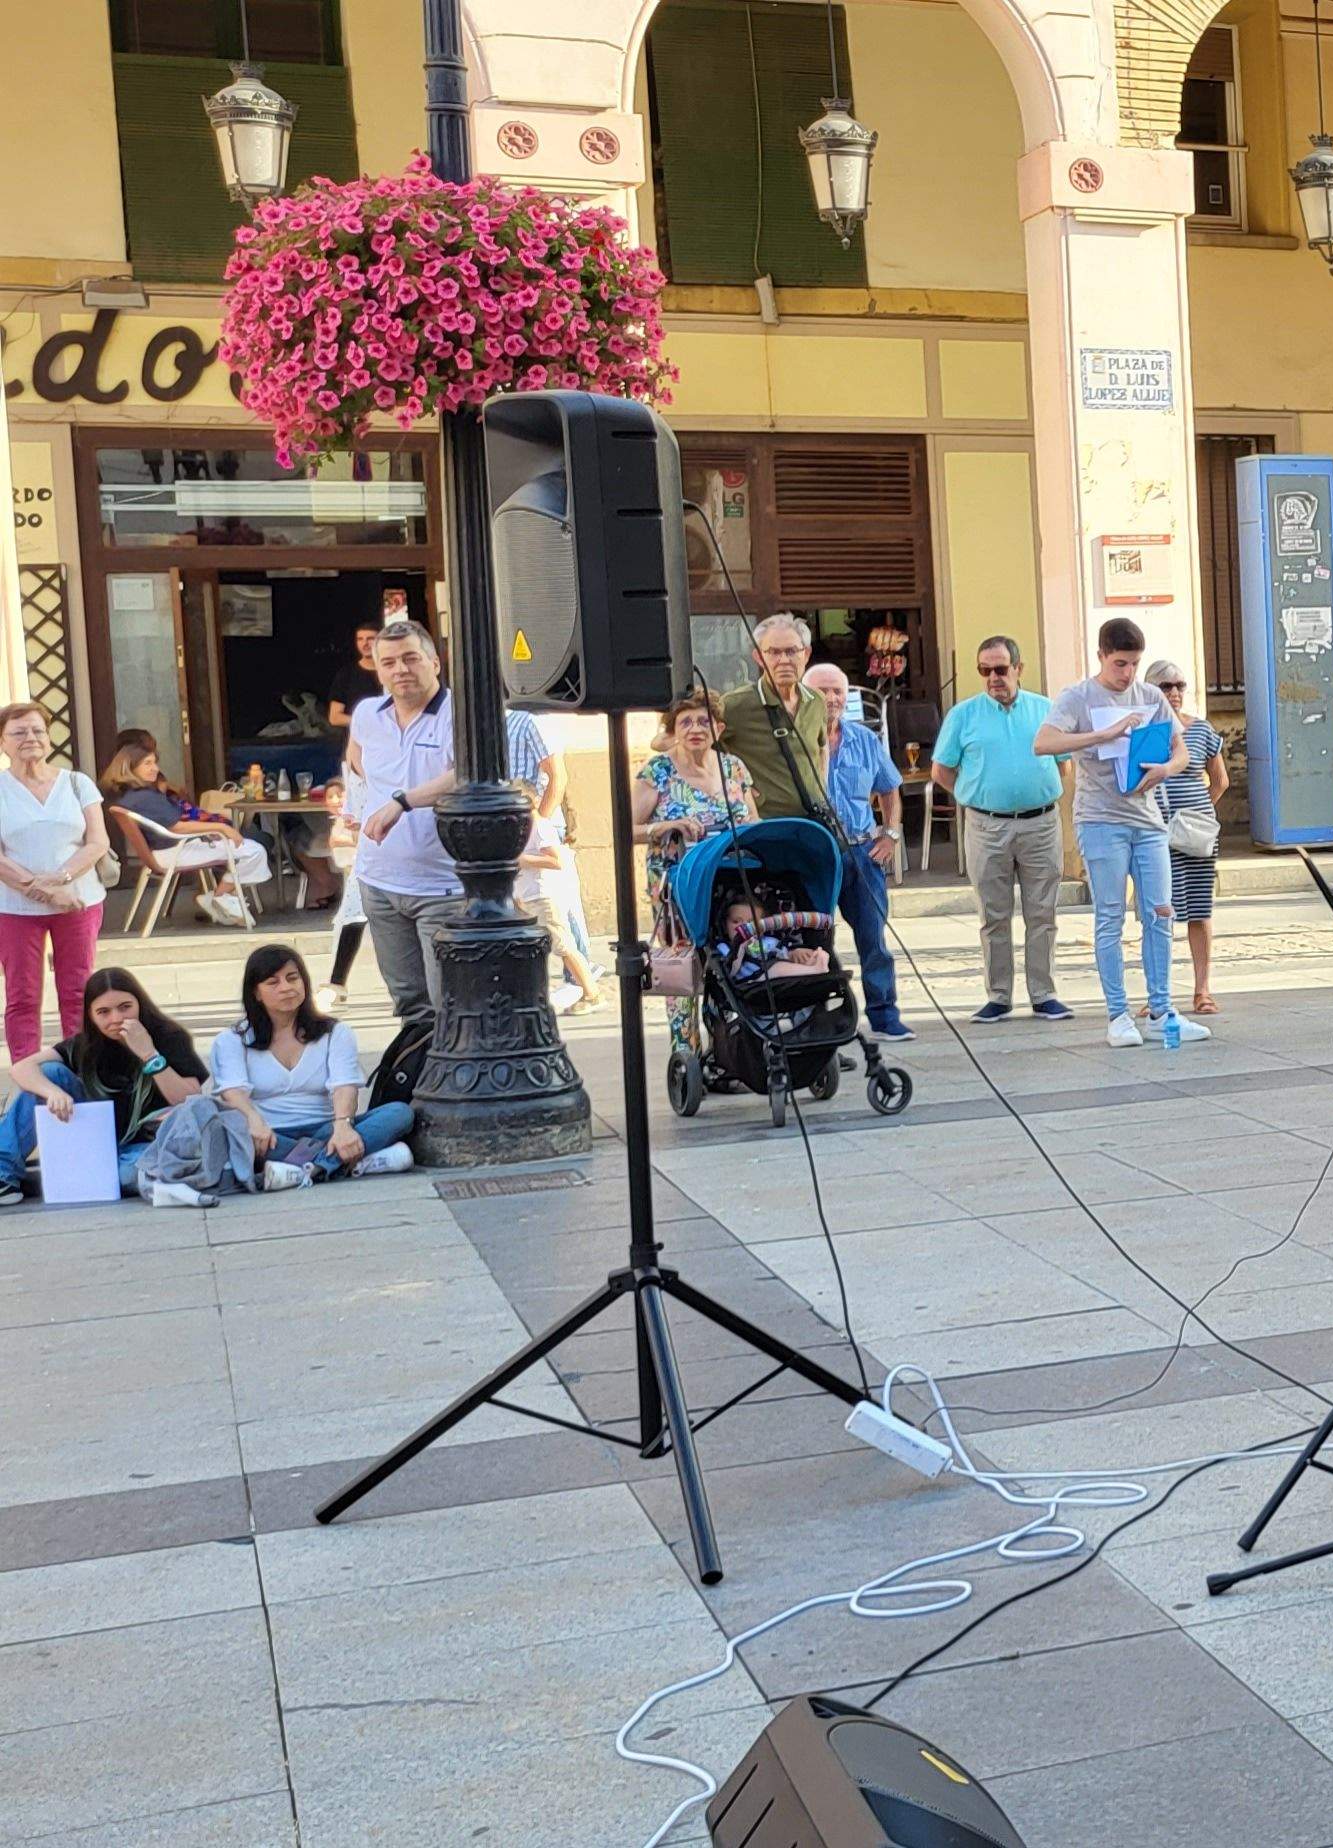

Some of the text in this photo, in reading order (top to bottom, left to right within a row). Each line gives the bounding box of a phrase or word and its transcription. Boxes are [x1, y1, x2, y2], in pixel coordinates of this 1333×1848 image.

[1108, 357, 1165, 371] PLAZA DE
[1126, 373, 1160, 386] LUIS
[1087, 387, 1127, 401] LOPEZ
